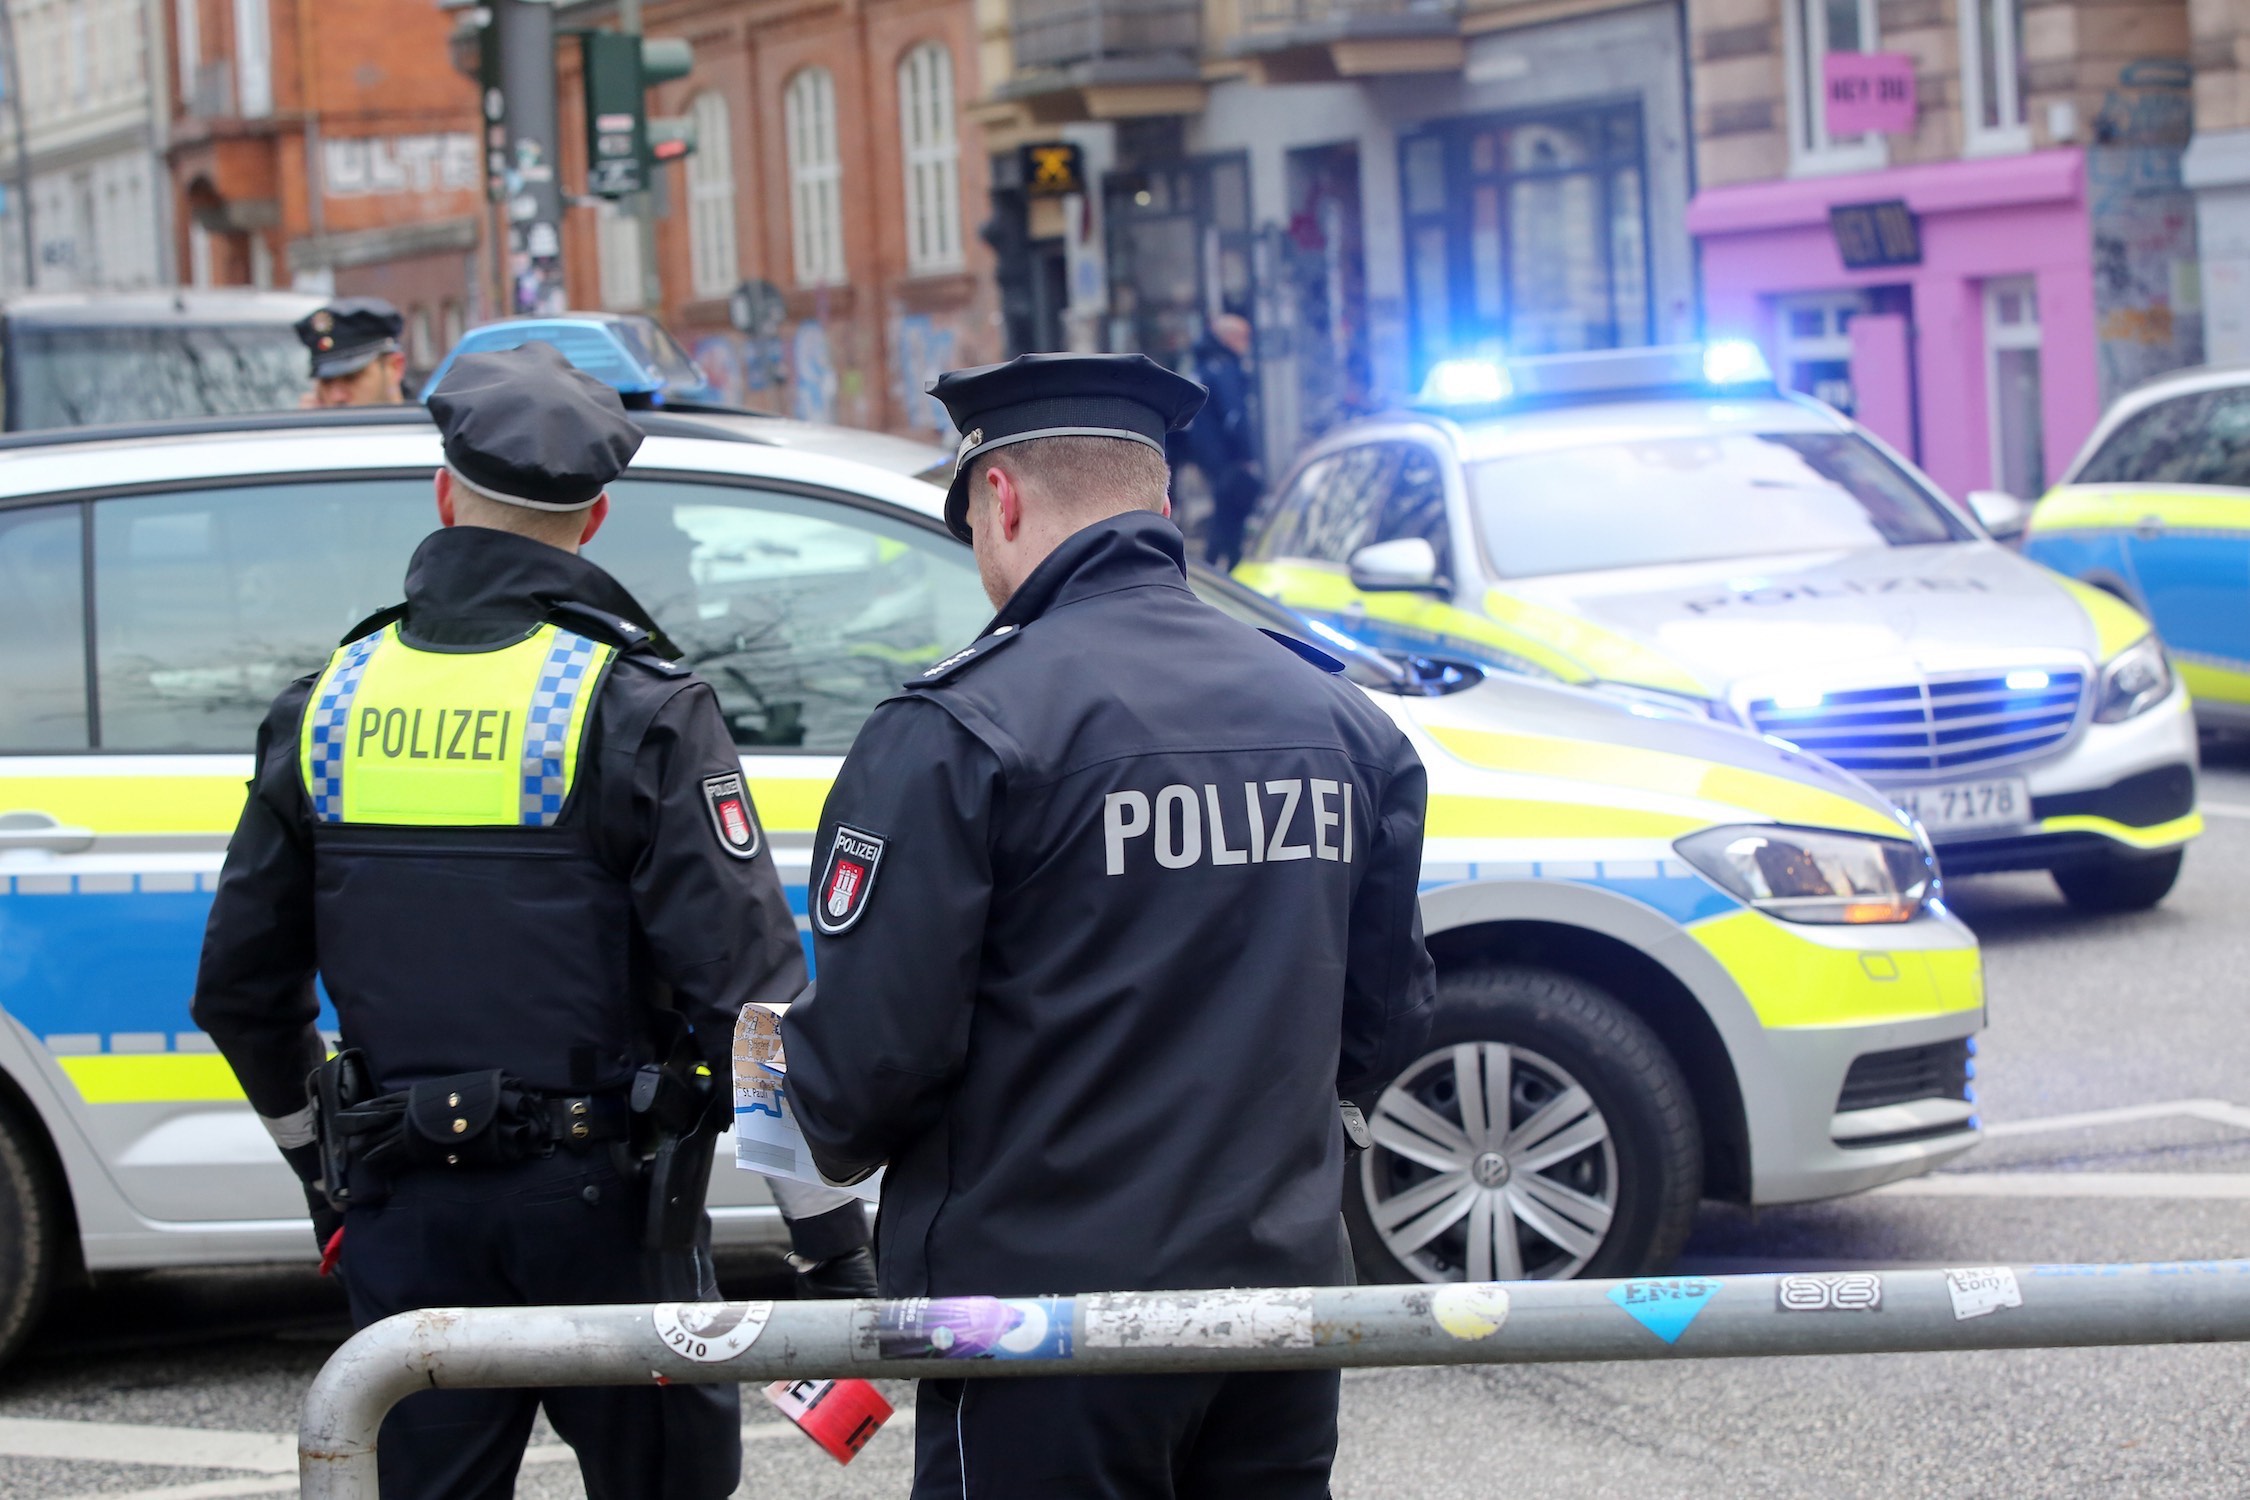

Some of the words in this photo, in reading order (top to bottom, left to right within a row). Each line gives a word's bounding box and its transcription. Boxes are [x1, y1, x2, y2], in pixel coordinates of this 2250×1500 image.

[1684, 577, 1990, 615] POLIZEI
[357, 707, 511, 761] POLIZEI
[707, 780, 739, 798] POLIZEI
[1939, 784, 2015, 820] 7178
[1103, 778, 1353, 876] POLIZEI
[836, 835, 879, 862] POLIZEI
[753, 1088, 768, 1099] Pauli
[664, 1326, 707, 1358] 1910
